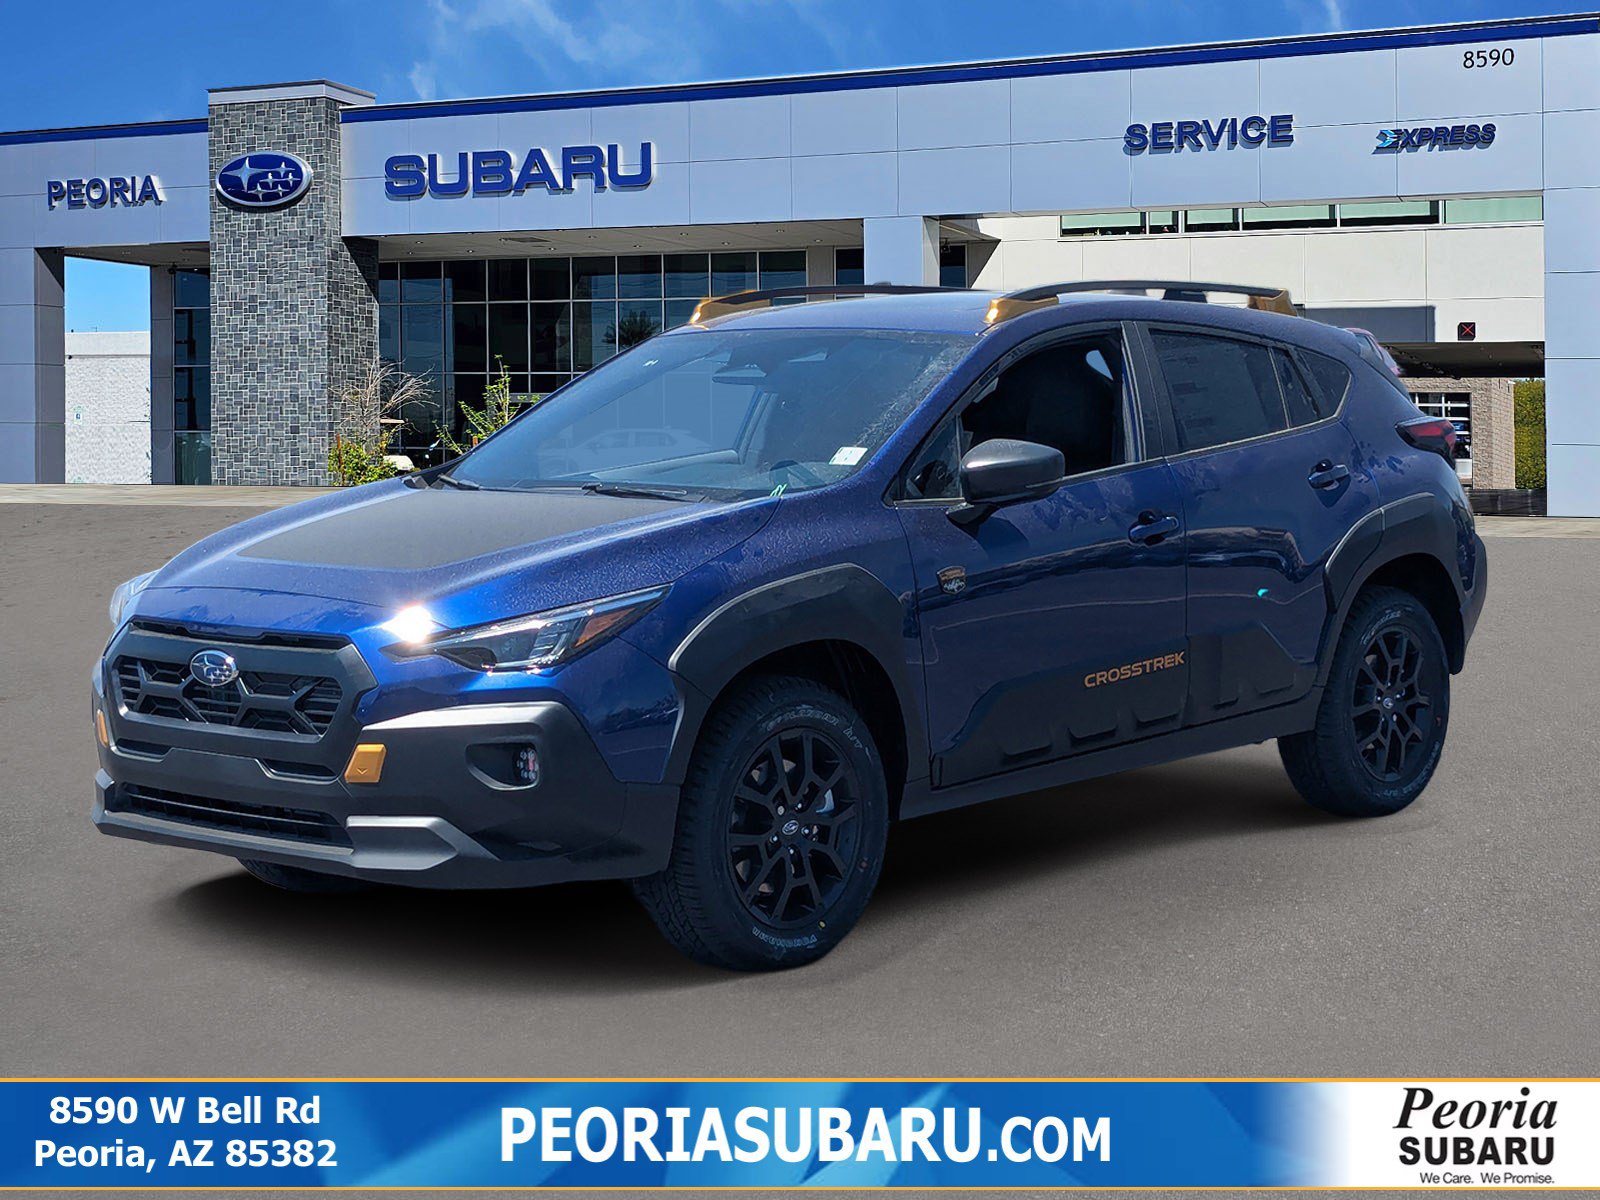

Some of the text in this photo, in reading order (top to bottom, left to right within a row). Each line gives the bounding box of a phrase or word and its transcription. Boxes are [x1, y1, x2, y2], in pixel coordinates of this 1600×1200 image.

[1462, 48, 1516, 70] 8590
[1124, 114, 1295, 152] SERVICE
[1376, 122, 1497, 149] EXPRESS
[384, 141, 653, 198] SUBARU
[47, 174, 162, 208] PEORIA
[1083, 650, 1186, 689] CROSSTREK
